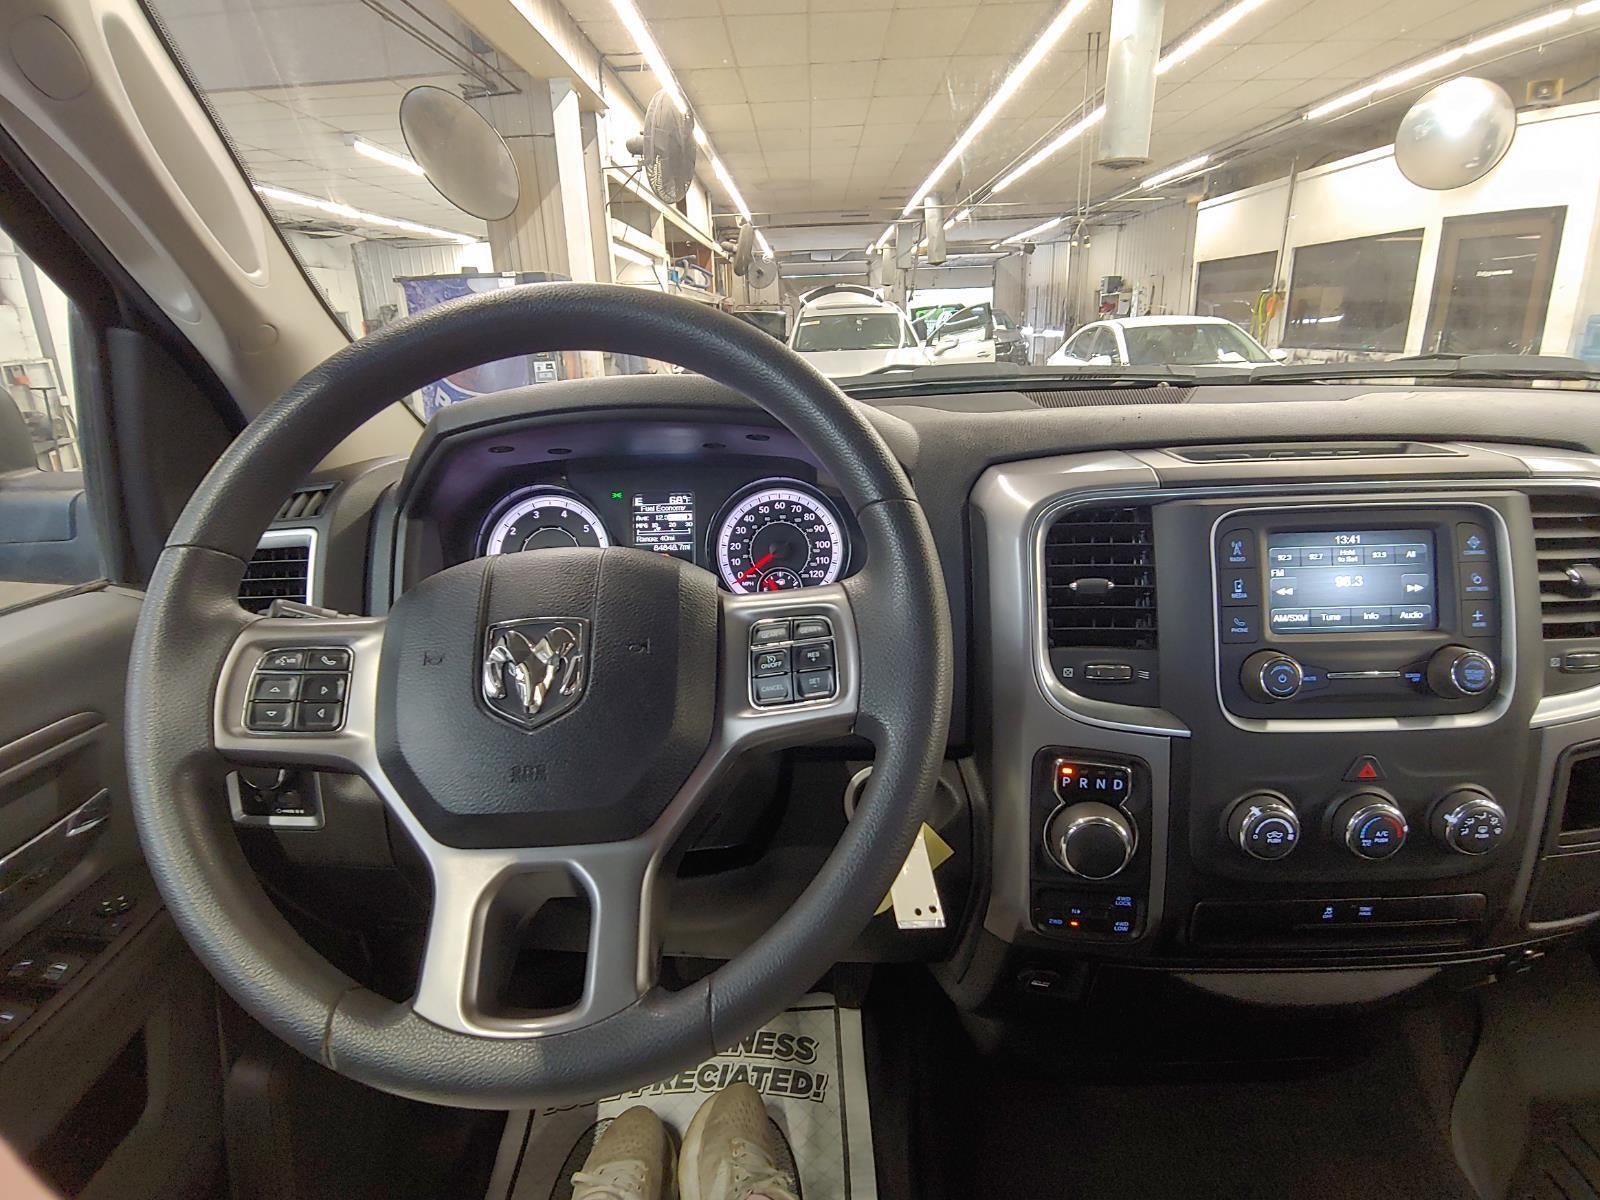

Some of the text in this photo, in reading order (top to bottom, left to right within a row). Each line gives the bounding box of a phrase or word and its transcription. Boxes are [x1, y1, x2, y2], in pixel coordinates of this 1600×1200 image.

[758, 506, 770, 514] 50
[774, 502, 786, 510] 60
[790, 504, 802, 513] 70
[532, 510, 540, 519] 3
[560, 510, 568, 518] 4
[743, 514, 755, 522] 40
[804, 512, 816, 521] 80
[510, 527, 517, 536] 2
[583, 524, 590, 533] 5
[735, 526, 747, 534] 30
[814, 524, 825, 533] 90
[1335, 534, 1360, 544] 13:41
[730, 542, 742, 550] 20
[815, 540, 830, 548] 100
[1406, 550, 1416, 558] All
[816, 556, 830, 564] 110
[808, 570, 824, 578] 120
[1270, 568, 1284, 577] FM
[1320, 614, 1342, 622] Tune
[1364, 612, 1380, 620] Info
[1400, 610, 1424, 619] Audio
[1062, 778, 1124, 790] P R N D
[720, 1030, 818, 1064] NESS
